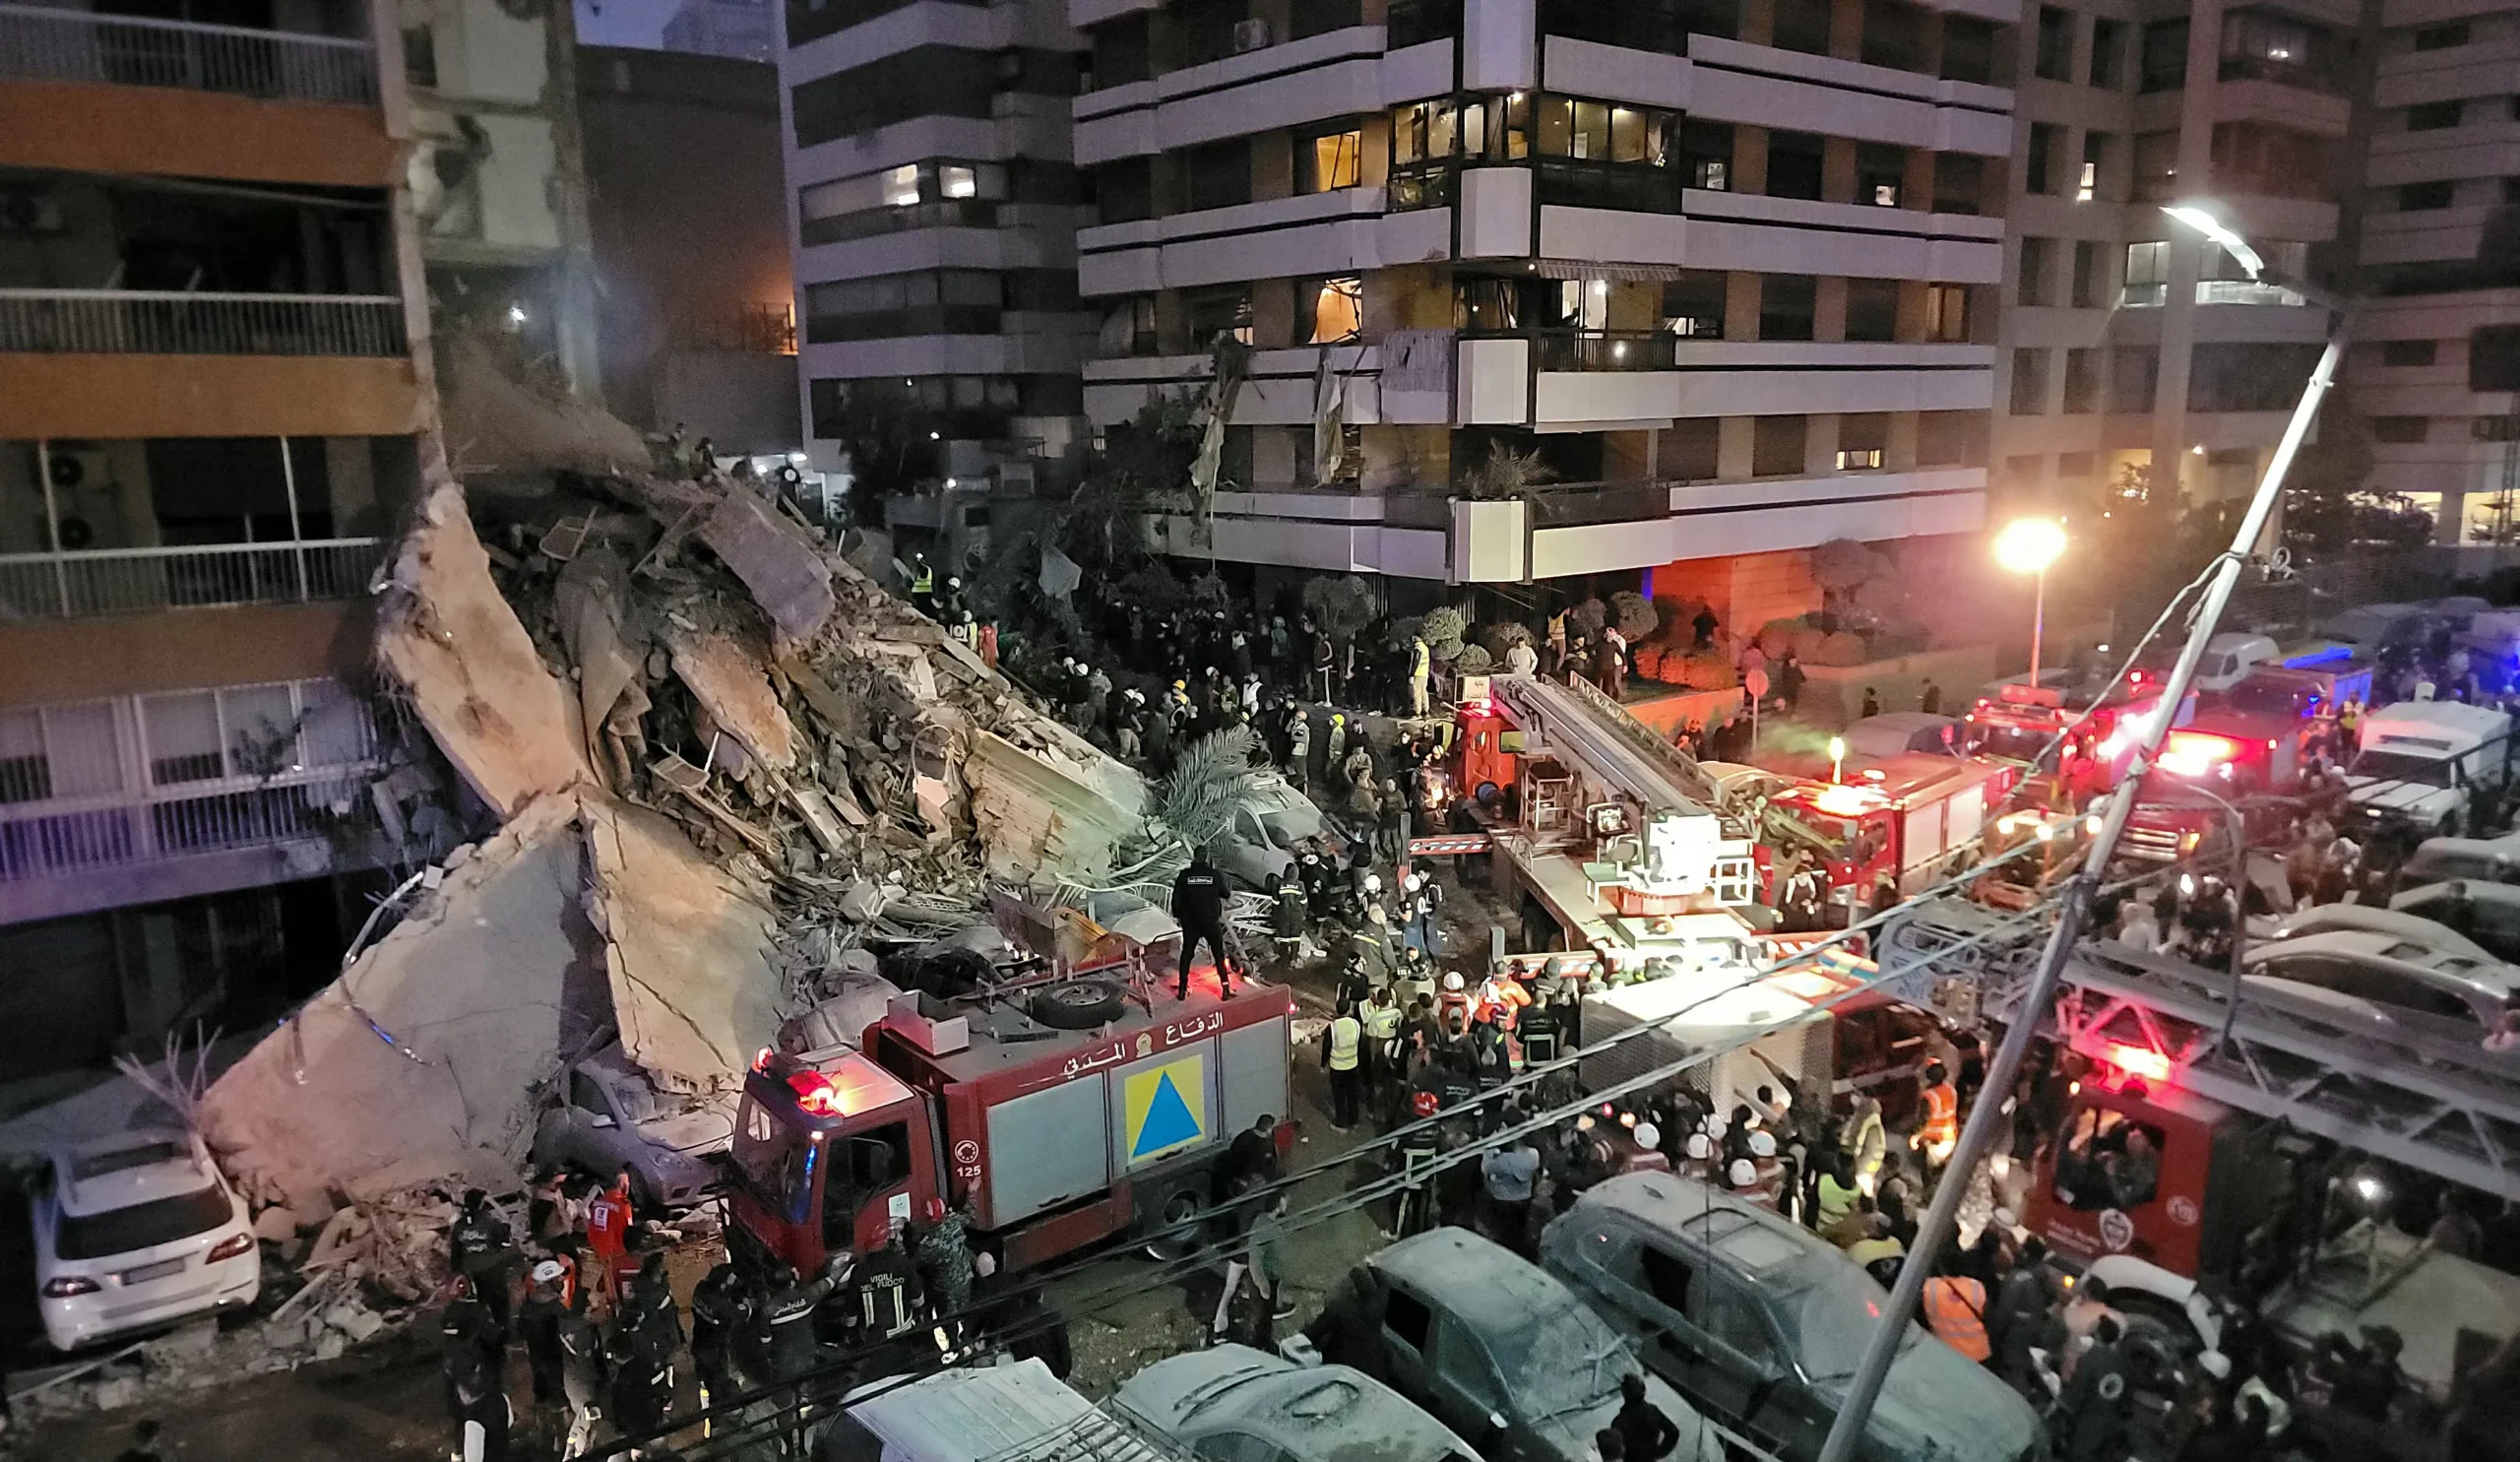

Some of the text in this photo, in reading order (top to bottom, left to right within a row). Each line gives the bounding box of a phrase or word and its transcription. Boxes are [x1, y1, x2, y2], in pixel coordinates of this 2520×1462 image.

[957, 1165, 981, 1177] 125
[870, 1272, 893, 1283] VIGILI
[877, 1277, 905, 1289] FUOCO
